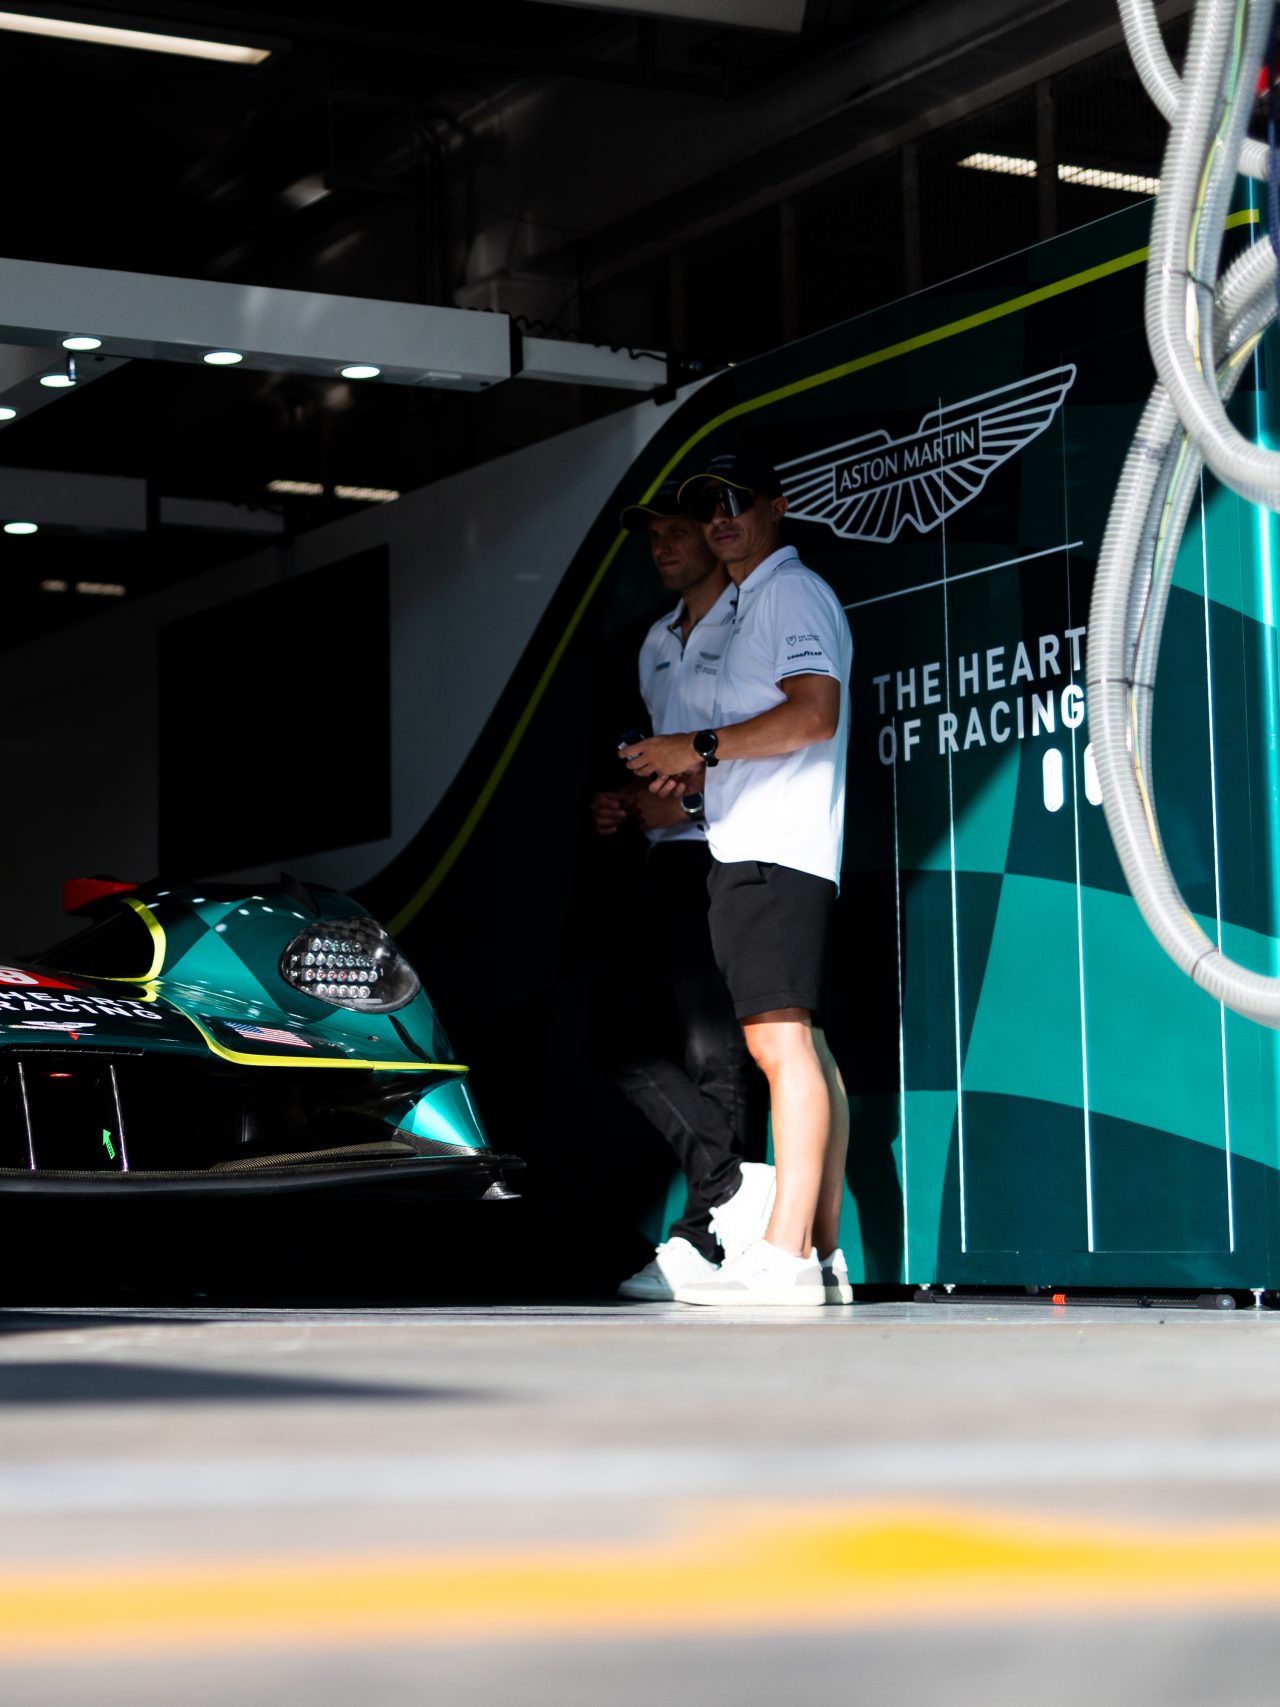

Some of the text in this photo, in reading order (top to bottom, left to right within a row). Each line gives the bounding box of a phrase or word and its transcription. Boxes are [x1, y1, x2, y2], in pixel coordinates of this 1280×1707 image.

[839, 426, 975, 493] ASTON MARTIN
[873, 626, 1087, 715] THE HEART
[878, 684, 1086, 766] OF RACING
